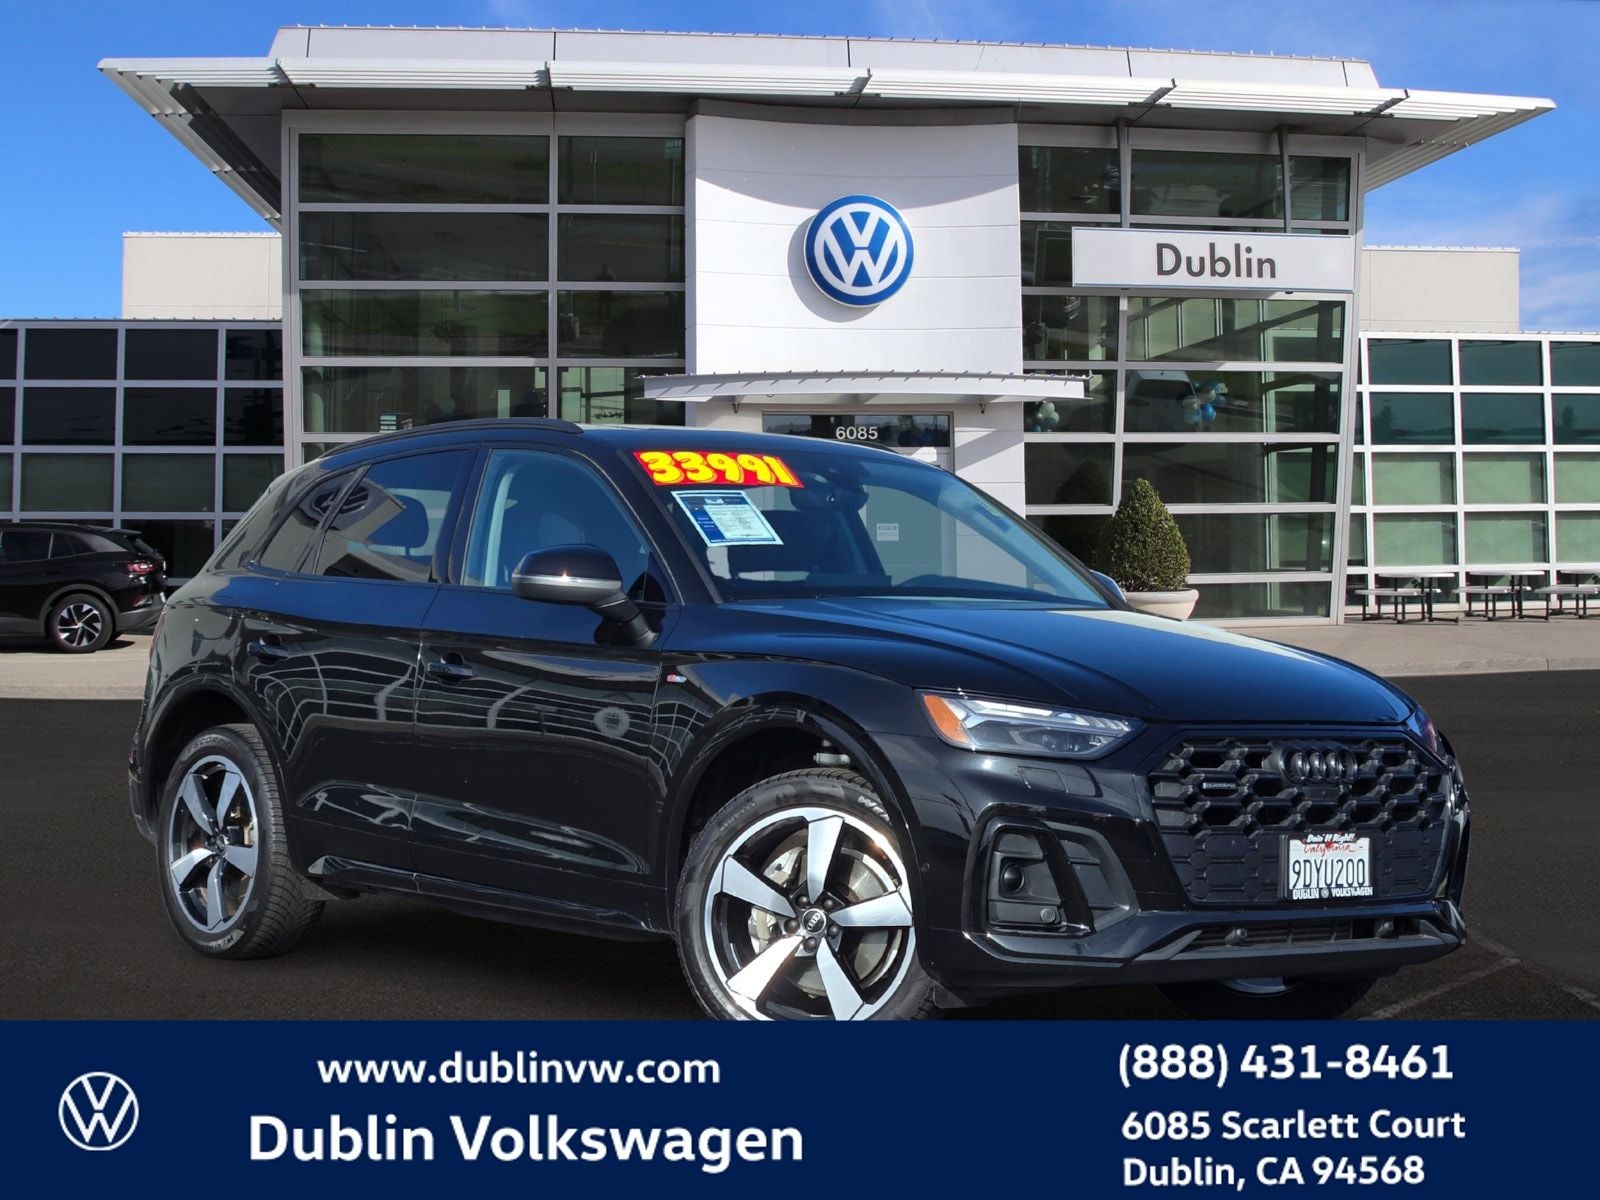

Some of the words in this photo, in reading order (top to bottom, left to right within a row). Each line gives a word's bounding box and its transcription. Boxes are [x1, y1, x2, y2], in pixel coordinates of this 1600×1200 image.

[1156, 243, 1277, 279] Dublin
[835, 426, 879, 441] 6085
[639, 451, 798, 486] 33991
[1292, 858, 1366, 889] 9DYU200
[1292, 887, 1320, 900] DUBLIN
[1331, 886, 1374, 898] VOLKSWAGEN
